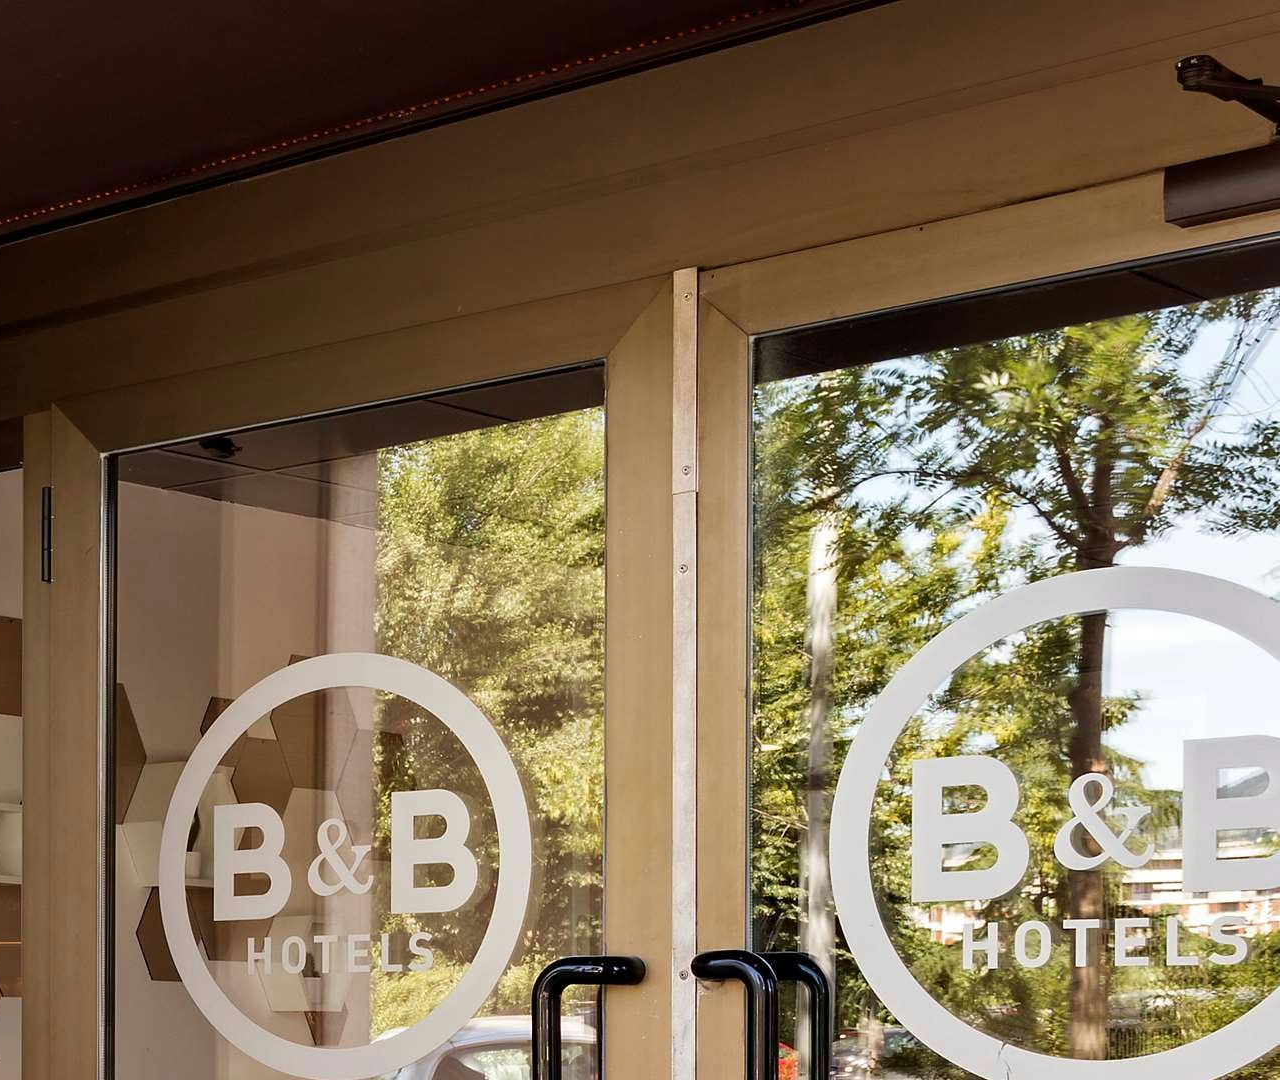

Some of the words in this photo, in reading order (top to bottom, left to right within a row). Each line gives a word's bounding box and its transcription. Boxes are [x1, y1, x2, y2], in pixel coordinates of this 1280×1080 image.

[214, 789, 478, 921] B&B
[247, 932, 435, 976] HOTELS
[962, 916, 1249, 969] HOTELS
